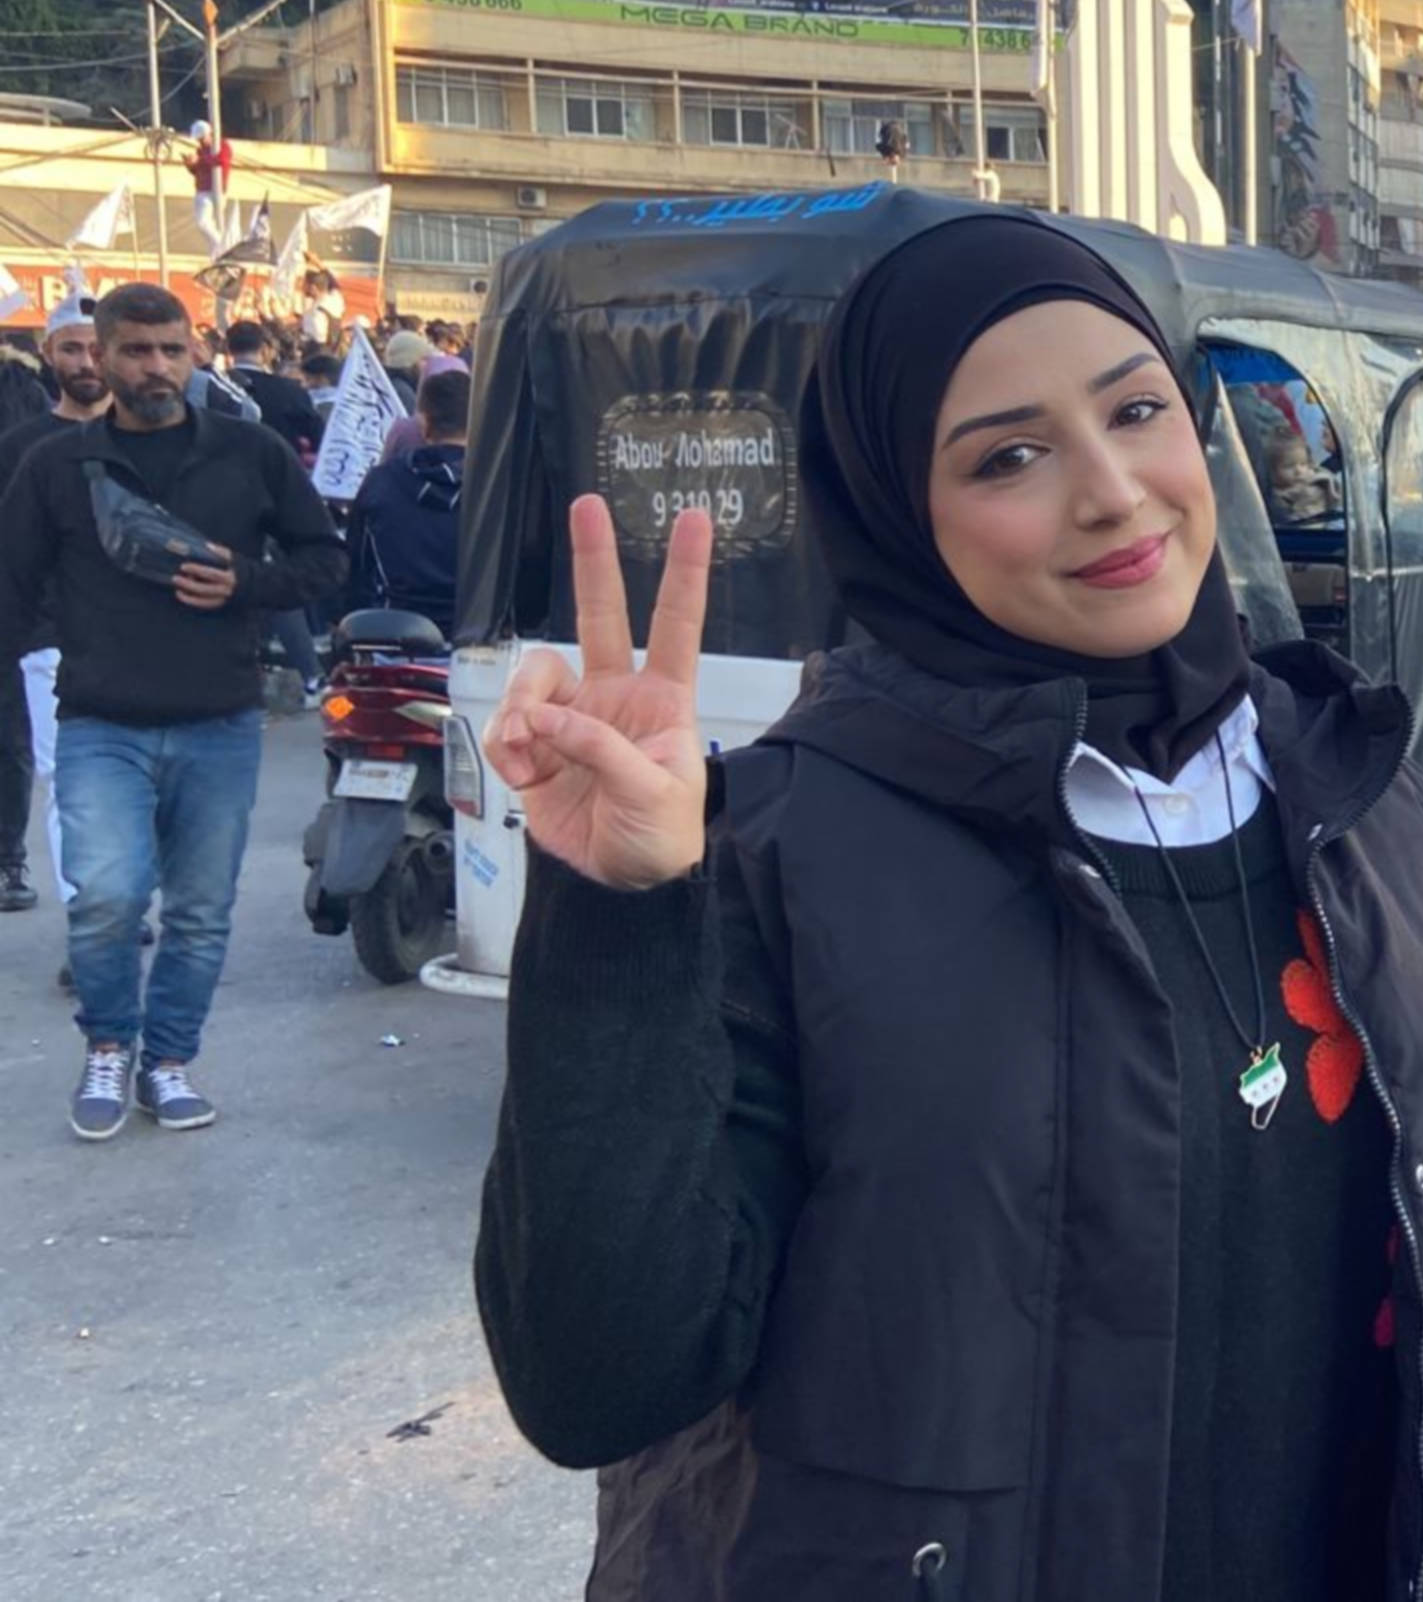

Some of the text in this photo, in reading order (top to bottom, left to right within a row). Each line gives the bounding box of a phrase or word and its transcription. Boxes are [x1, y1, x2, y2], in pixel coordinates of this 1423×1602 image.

[620, 5, 859, 38] MEGA BRAND
[615, 431, 663, 469] Abou
